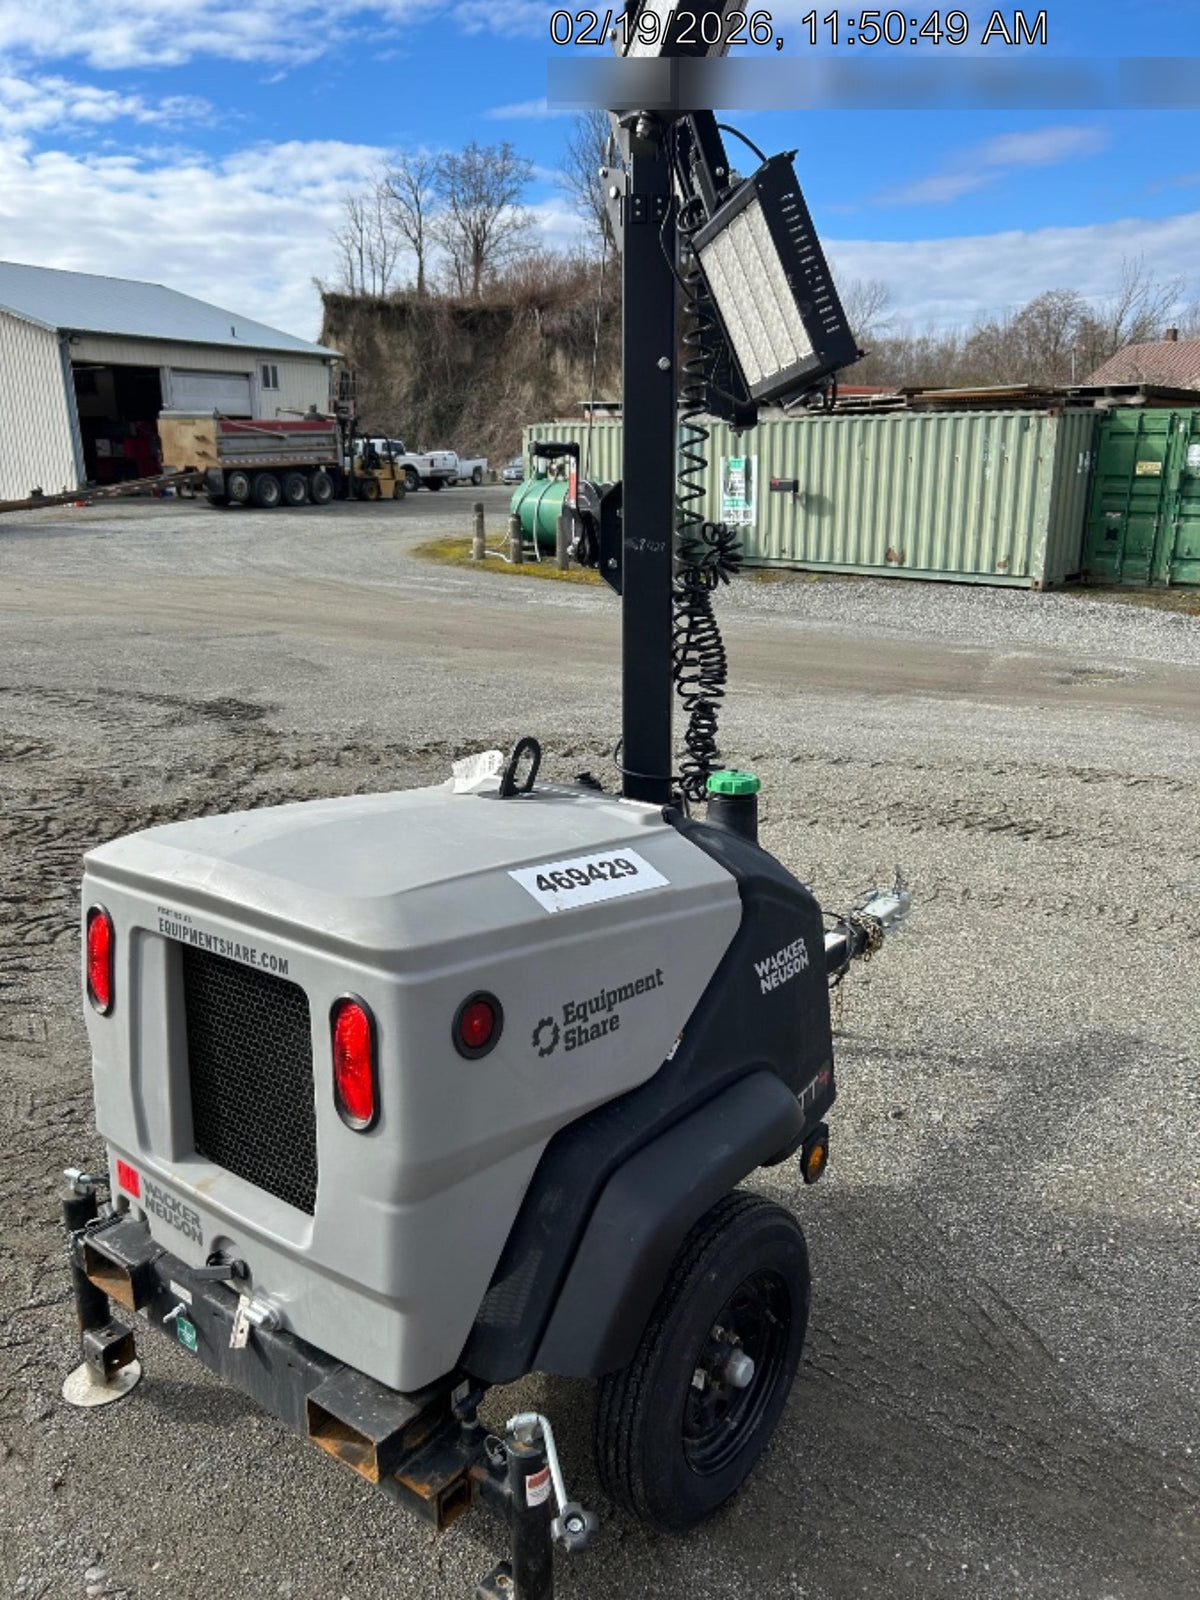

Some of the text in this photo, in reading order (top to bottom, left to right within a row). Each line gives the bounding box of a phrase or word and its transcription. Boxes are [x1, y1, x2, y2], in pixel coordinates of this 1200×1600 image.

[536, 857, 639, 893] 469429
[158, 917, 289, 975] EQUIPMENTSHARE.COM
[753, 937, 806, 977] WACKER
[760, 950, 810, 995] NEUSON
[562, 967, 665, 1027] Equipment
[563, 1014, 621, 1052] Share
[143, 1177, 202, 1229] WACKER
[144, 1195, 204, 1247] NEUSON
